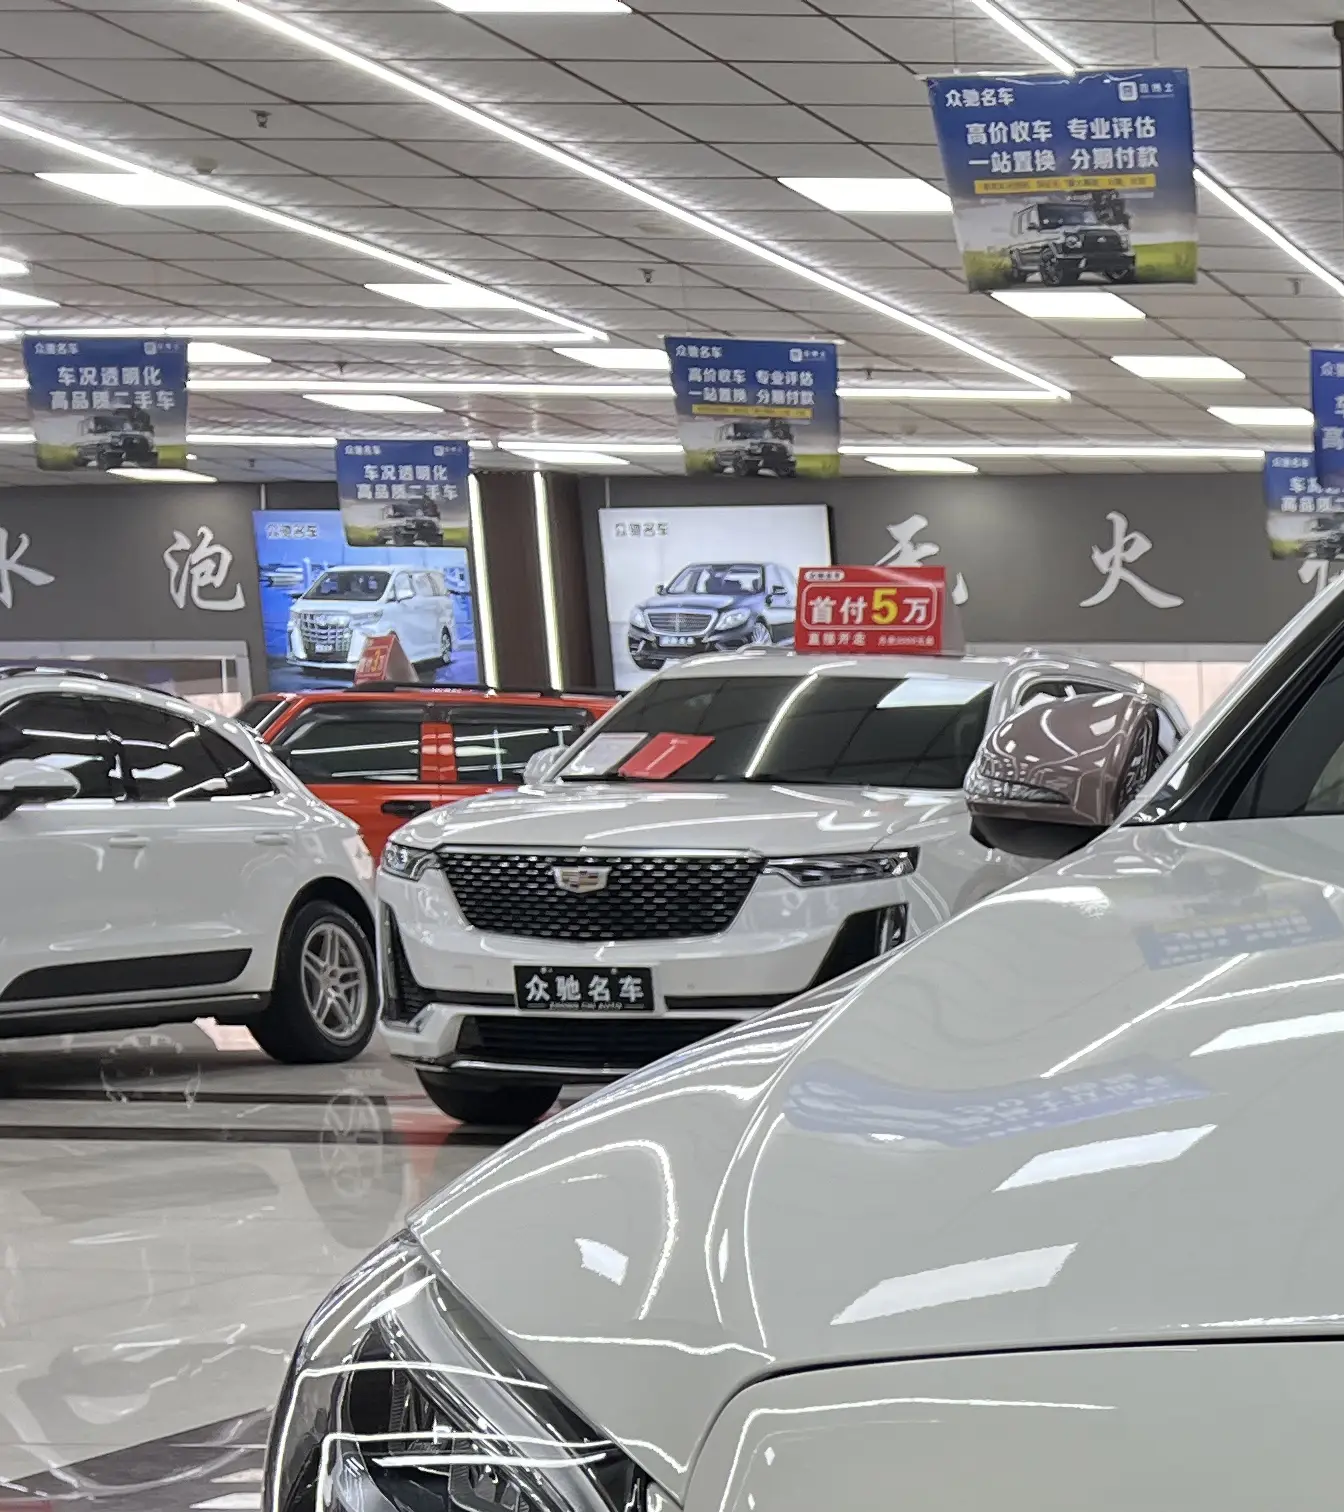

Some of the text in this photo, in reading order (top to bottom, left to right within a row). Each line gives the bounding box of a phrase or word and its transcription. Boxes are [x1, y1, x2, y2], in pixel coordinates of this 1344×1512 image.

[945, 87, 1015, 108] 众驰名车
[965, 116, 1156, 145] 高价收车 专业评估
[968, 146, 1159, 173] 一站置换 分期付款
[57, 366, 162, 386] 车况透明化
[49, 390, 175, 410] 高品质二手车
[363, 464, 448, 481] 车况透明化
[356, 484, 459, 500] 高品质二手车
[807, 587, 931, 625] 首付5万
[525, 974, 645, 1002] 众驰名车
